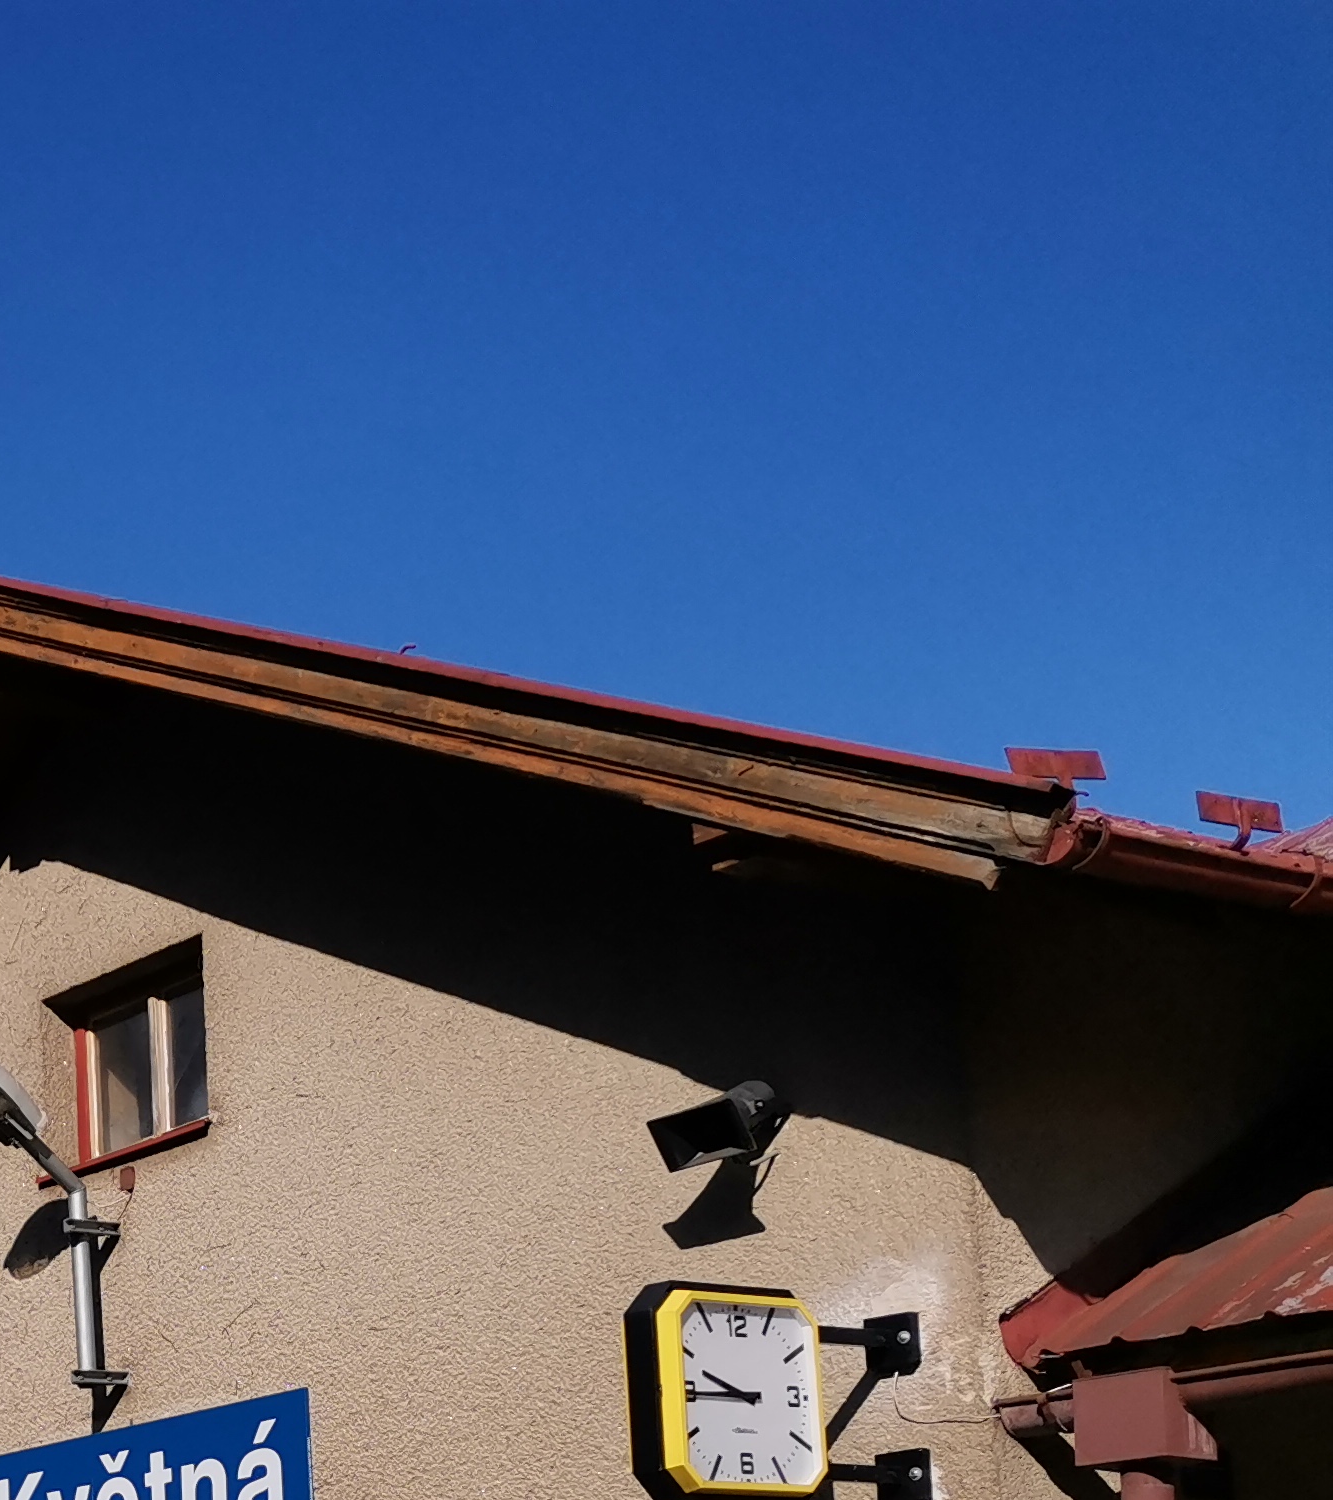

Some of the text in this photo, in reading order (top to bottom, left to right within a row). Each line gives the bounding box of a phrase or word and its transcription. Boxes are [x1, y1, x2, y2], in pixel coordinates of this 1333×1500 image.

[726, 1314, 748, 1338] 12
[786, 1385, 801, 1408] 3
[740, 1452, 755, 1475] 6
